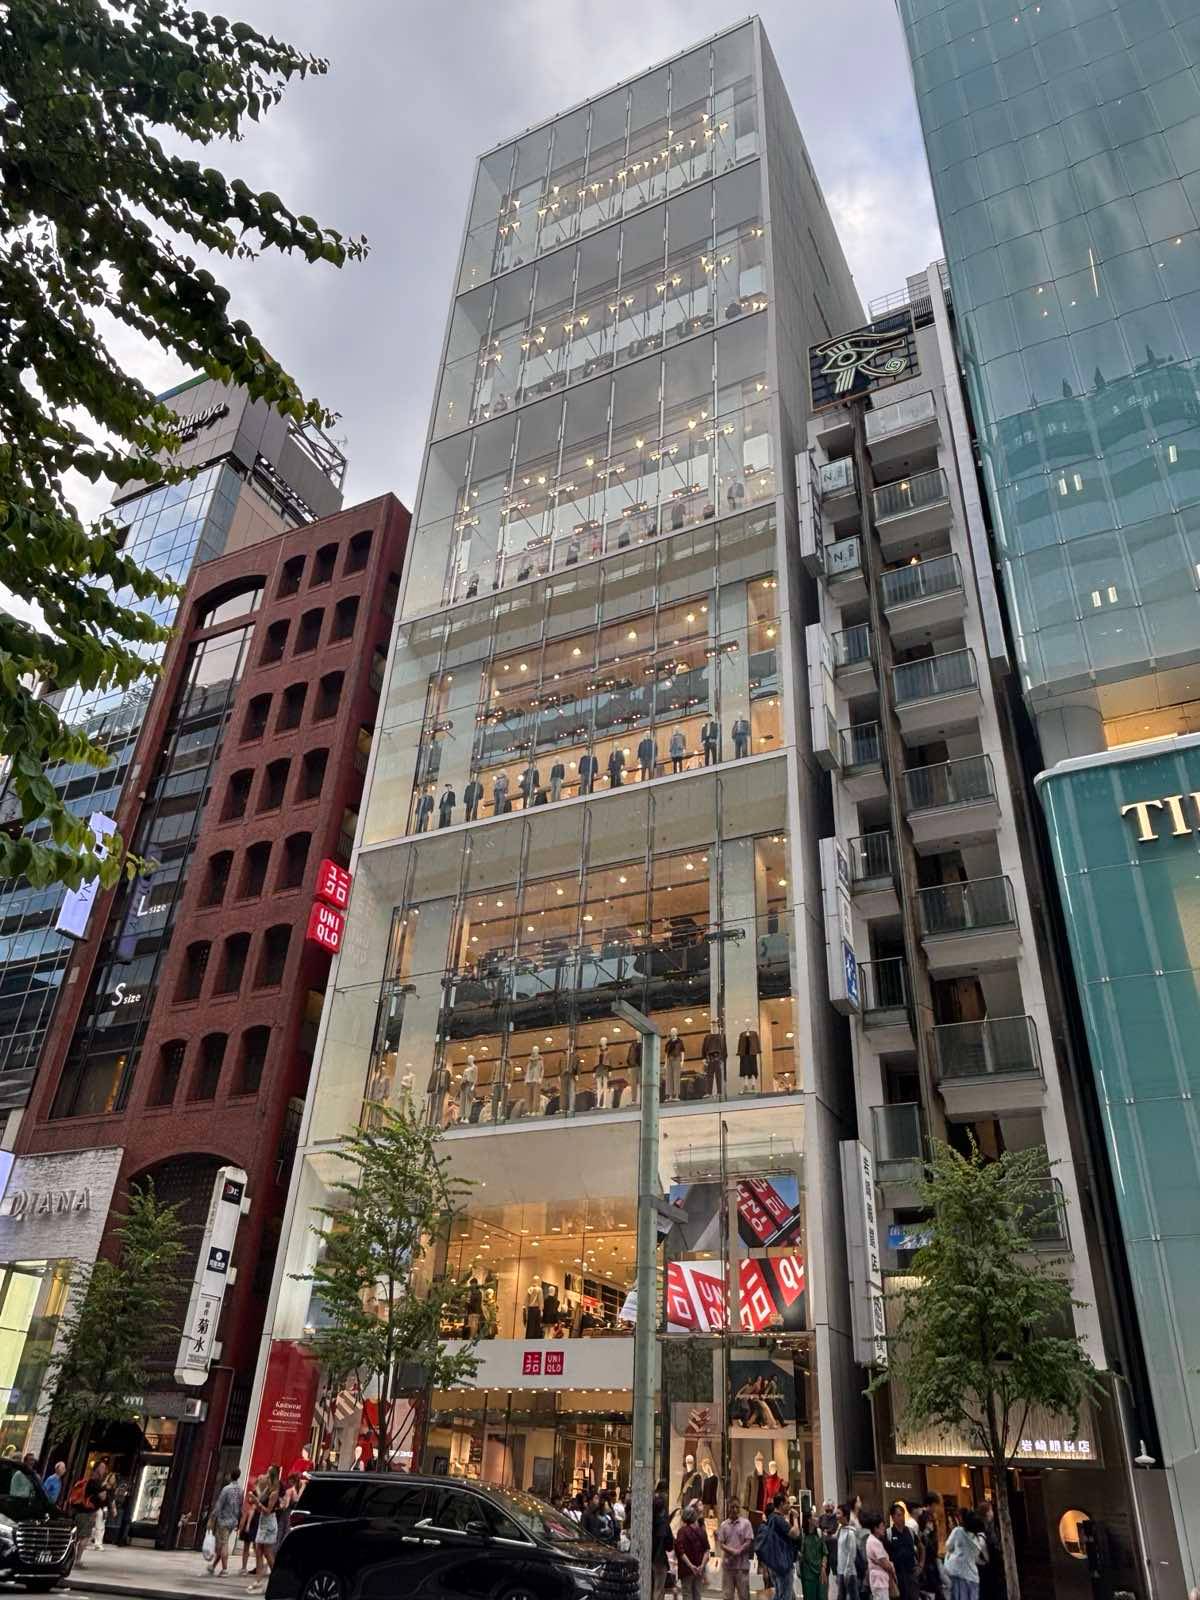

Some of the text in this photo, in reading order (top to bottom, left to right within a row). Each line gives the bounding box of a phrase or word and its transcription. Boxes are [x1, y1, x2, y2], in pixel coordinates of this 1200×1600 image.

[319, 907, 340, 932] UNI
[316, 923, 339, 947] QLO
[9, 1187, 91, 1222] DIANA
